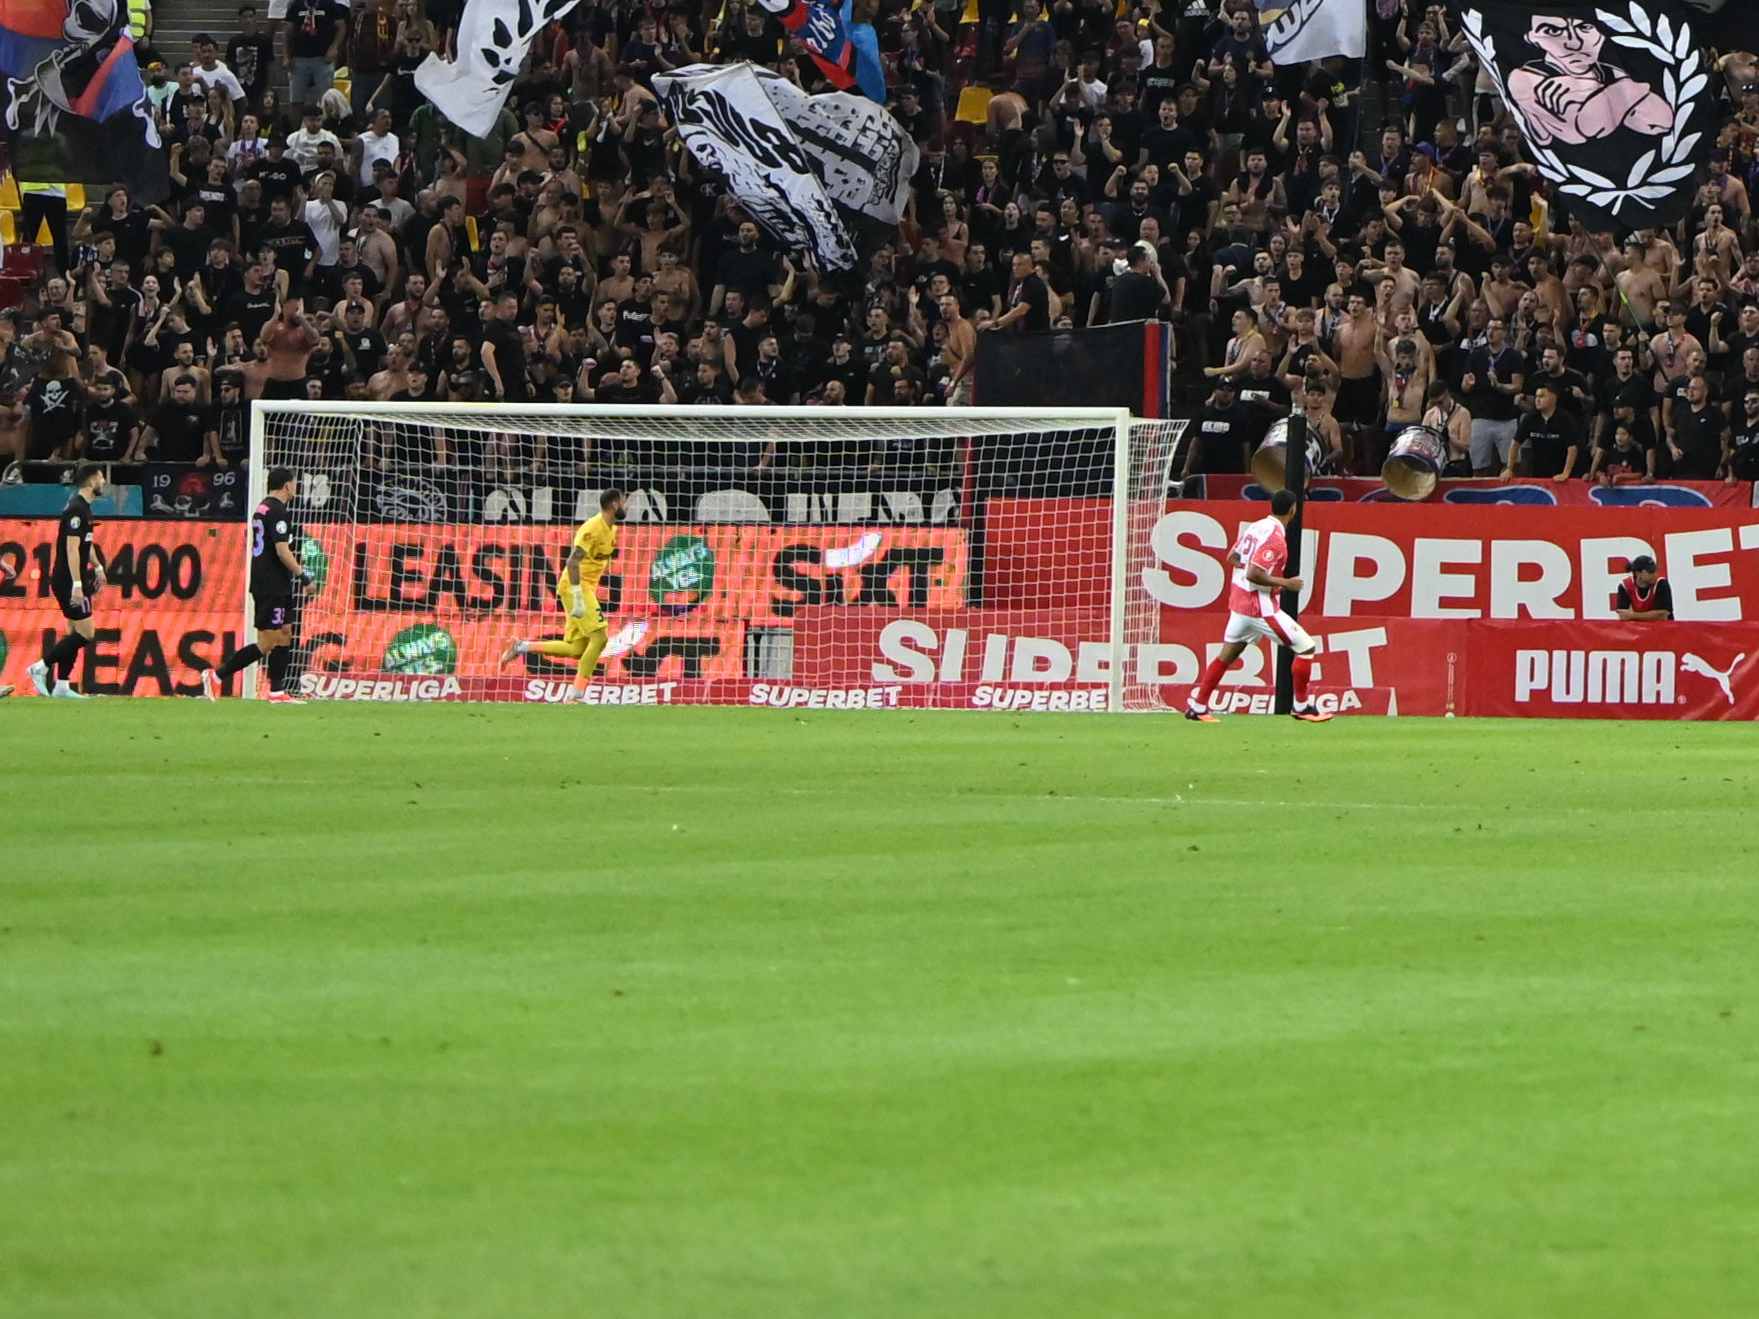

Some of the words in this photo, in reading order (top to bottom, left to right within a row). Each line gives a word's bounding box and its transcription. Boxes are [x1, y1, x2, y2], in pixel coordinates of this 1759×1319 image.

[152, 474, 171, 488] 19
[213, 471, 236, 487] 96
[301, 673, 462, 703] SUPERLIGA
[1515, 649, 1676, 705] PUMA
[525, 678, 677, 707] SUERBET
[750, 682, 902, 710] SUPERBET
[972, 685, 1110, 711] SUPERBE
